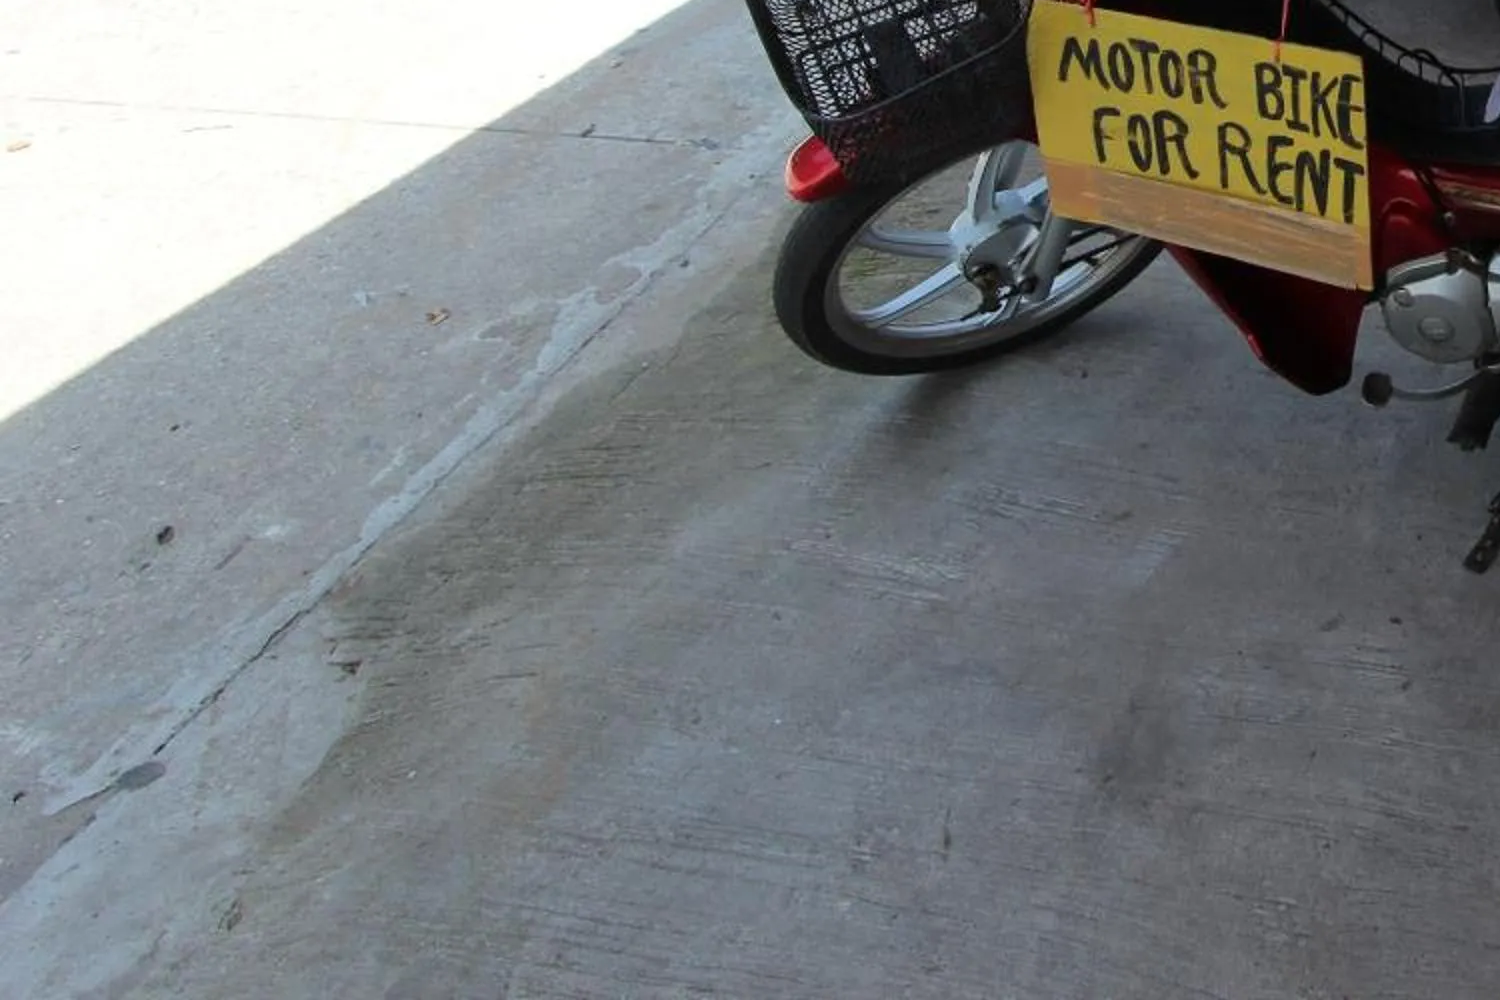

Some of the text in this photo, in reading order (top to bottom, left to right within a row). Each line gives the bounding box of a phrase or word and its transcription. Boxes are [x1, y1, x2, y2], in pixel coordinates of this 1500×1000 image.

[1058, 37, 1365, 150] MOTOR BIKE
[1093, 106, 1365, 225] FOR RENT
